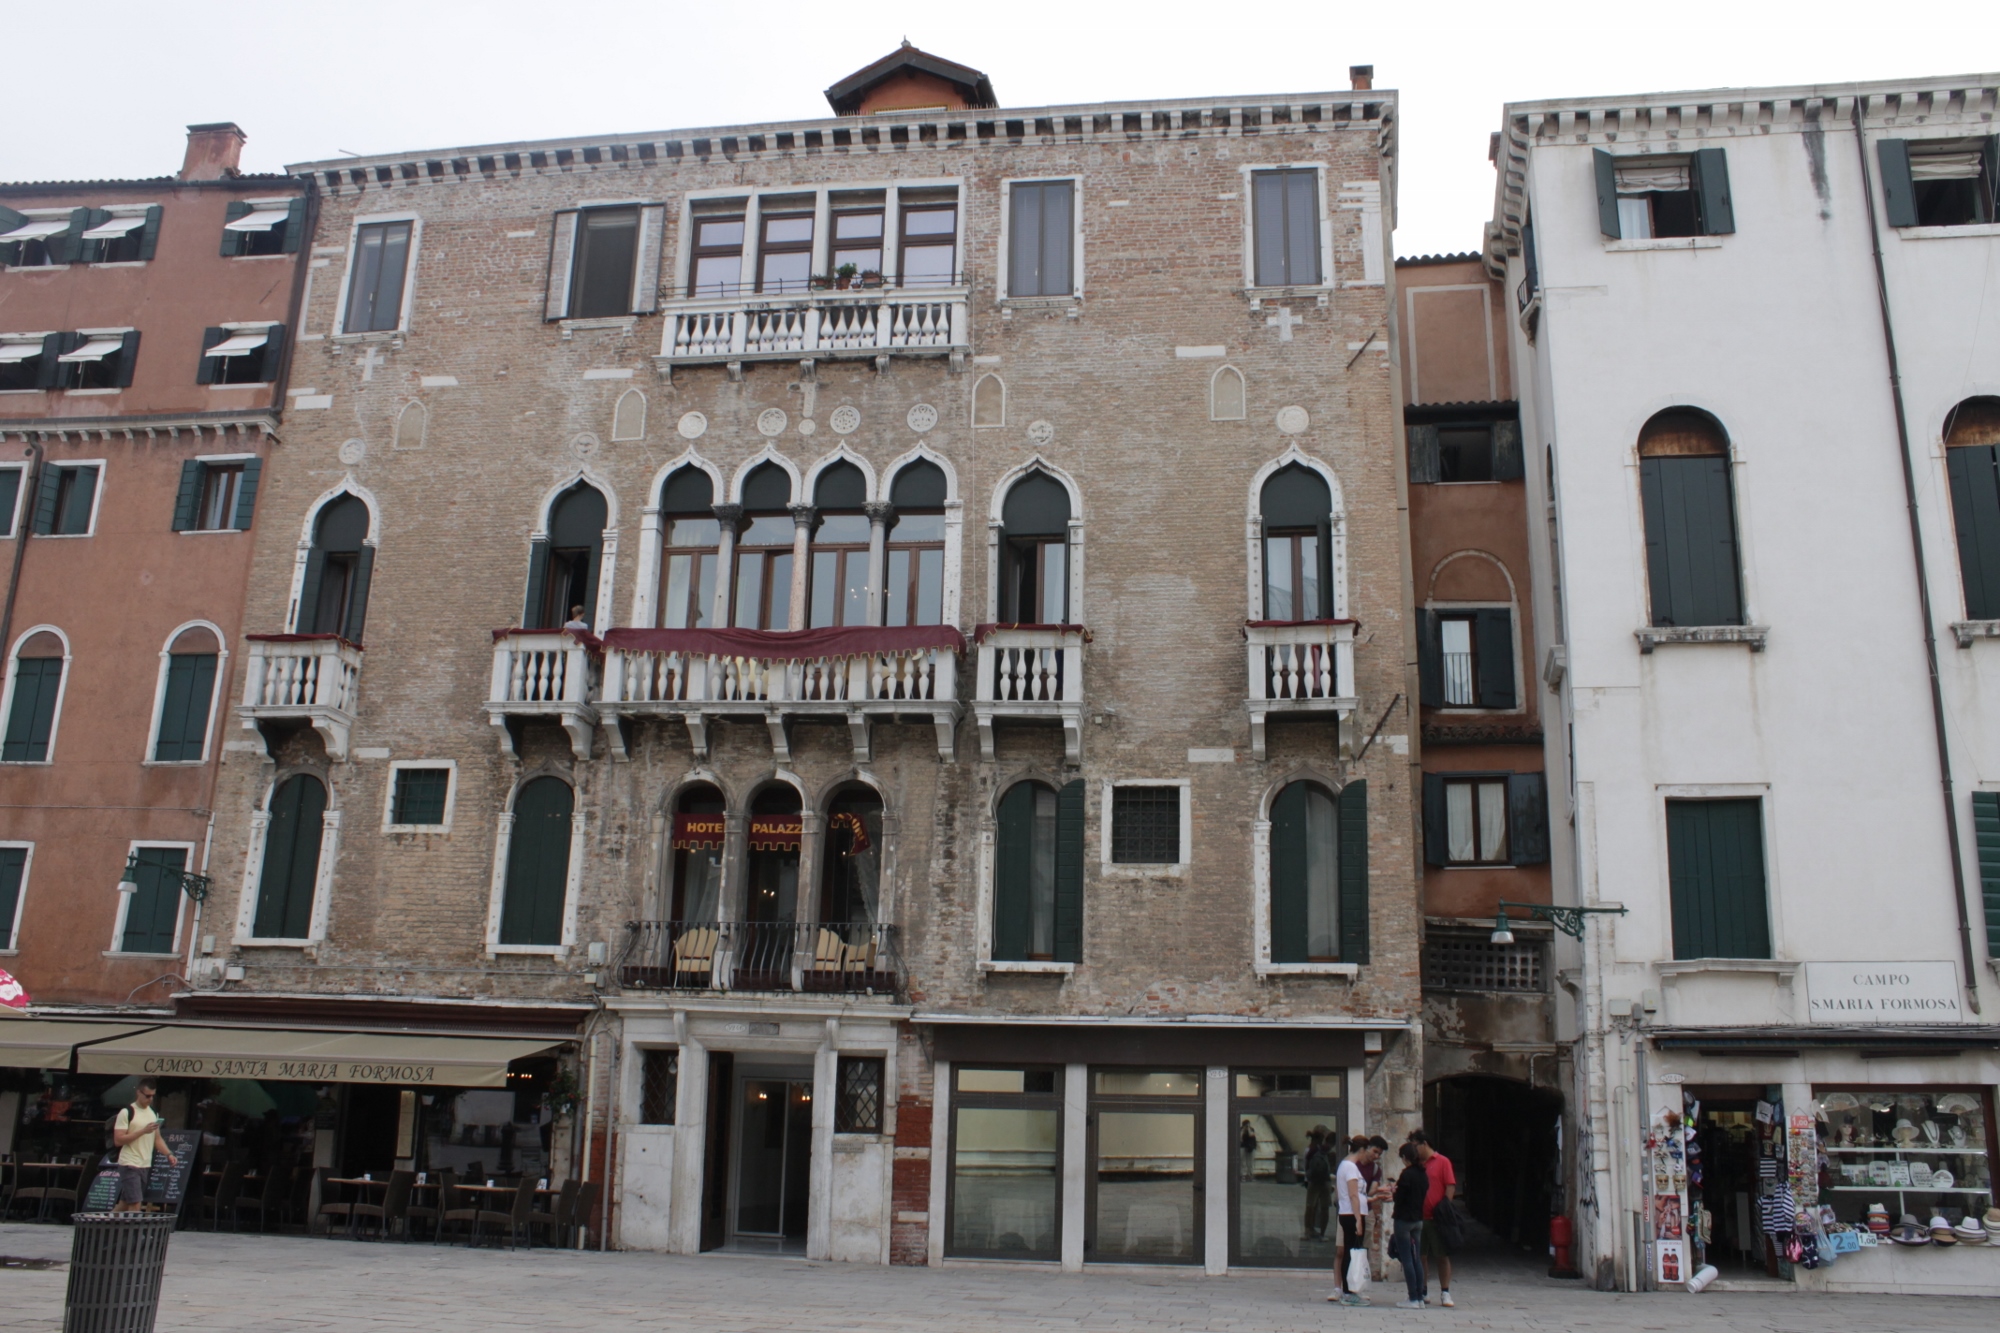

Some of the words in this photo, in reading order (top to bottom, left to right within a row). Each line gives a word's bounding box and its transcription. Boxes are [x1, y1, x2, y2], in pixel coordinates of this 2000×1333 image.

[687, 822, 725, 833] HOTE
[752, 823, 803, 834] PALAZZ
[1853, 974, 1910, 986] CAMPO
[1811, 998, 1874, 1010] S.MARIA
[1881, 998, 1957, 1010] FORMOSA
[143, 1057, 203, 1074] CAMPO
[211, 1059, 269, 1076] SANTA
[278, 1061, 338, 1079] MARIA
[349, 1063, 435, 1082] FORMOSA
[1833, 1234, 1845, 1250] 2
